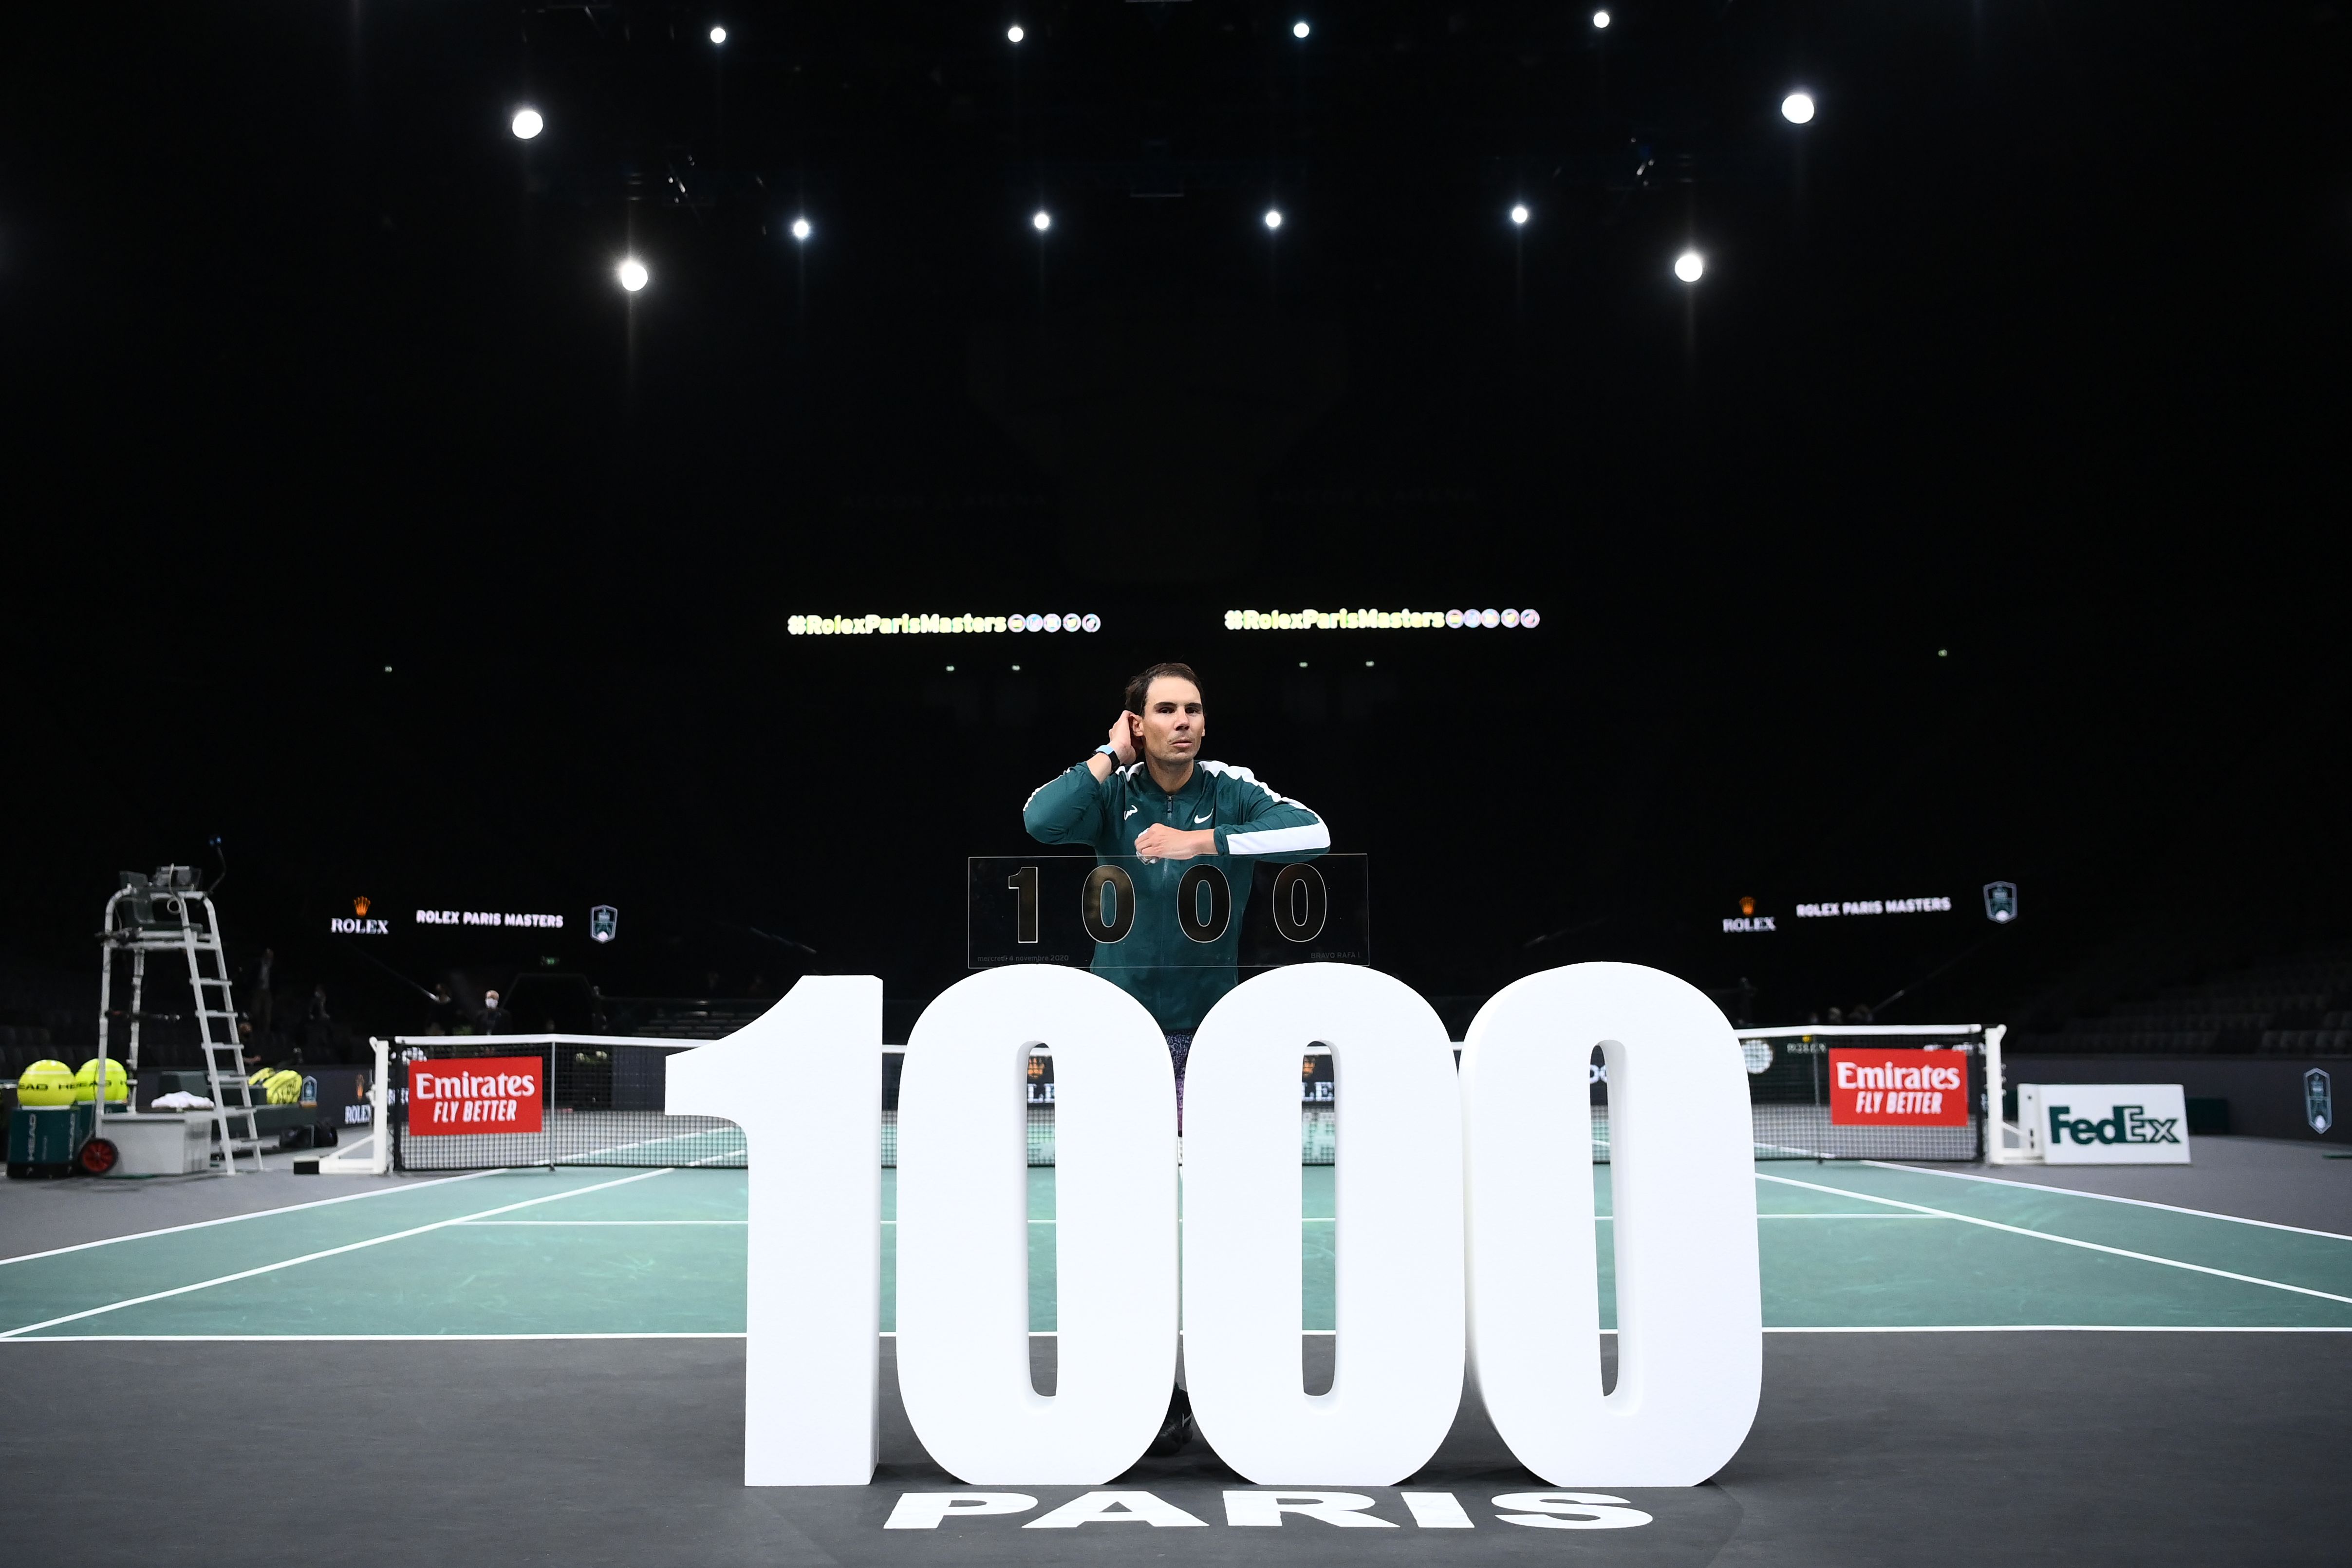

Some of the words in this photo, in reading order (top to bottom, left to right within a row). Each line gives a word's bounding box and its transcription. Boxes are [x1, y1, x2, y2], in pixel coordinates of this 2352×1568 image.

[787, 613, 1007, 635] #RolexParisMasters
[1225, 608, 1445, 630] #RolexParisMasters
[1796, 903, 1840, 917] ROLEX
[1842, 900, 1883, 915] PARIS
[1885, 897, 1951, 914] MASTERS
[331, 918, 389, 934] ROLEX
[416, 910, 460, 925] ROLEX
[463, 911, 502, 926] PARIS
[504, 913, 563, 928] MASTERS
[1722, 916, 1776, 933] ROLEX
[416, 1071, 535, 1100] Emirates
[1836, 1062, 1960, 1090] Emirates
[433, 1101, 459, 1122] FLY
[463, 1100, 517, 1122] BETTER
[1856, 1091, 1884, 1114] FLY
[1885, 1091, 1943, 1114] BETTER
[2049, 1106, 2180, 1144] FedEx
[665, 962, 1764, 1487] 1000
[883, 1490, 1653, 1529] PARIS
